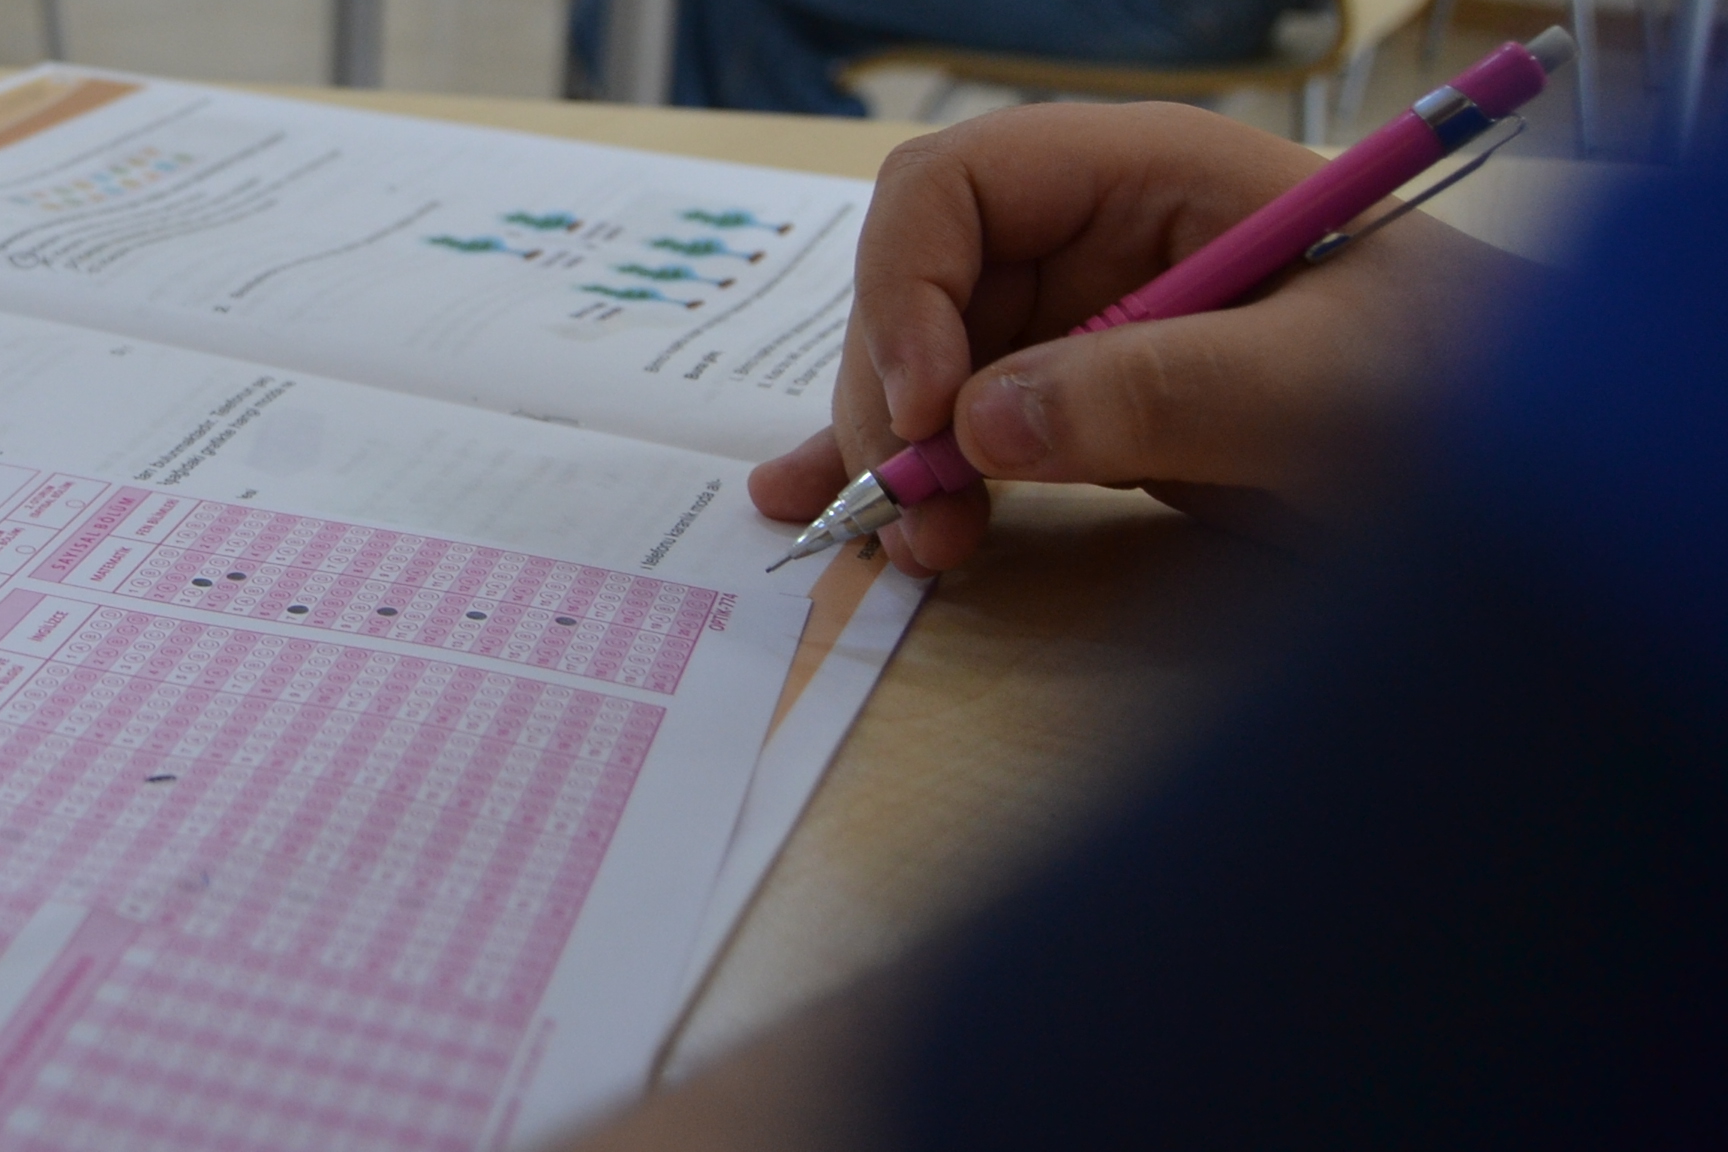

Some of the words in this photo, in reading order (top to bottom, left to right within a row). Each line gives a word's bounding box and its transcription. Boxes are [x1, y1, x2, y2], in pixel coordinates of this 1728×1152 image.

[51, 532, 101, 571] SAYISAL
[94, 496, 136, 531] BÖLÜM
[135, 523, 152, 537] FEN
[89, 546, 133, 583] MATEMATİK
[27, 610, 70, 643] İNGİLİZCE
[708, 592, 739, 632] OPTİK-774
